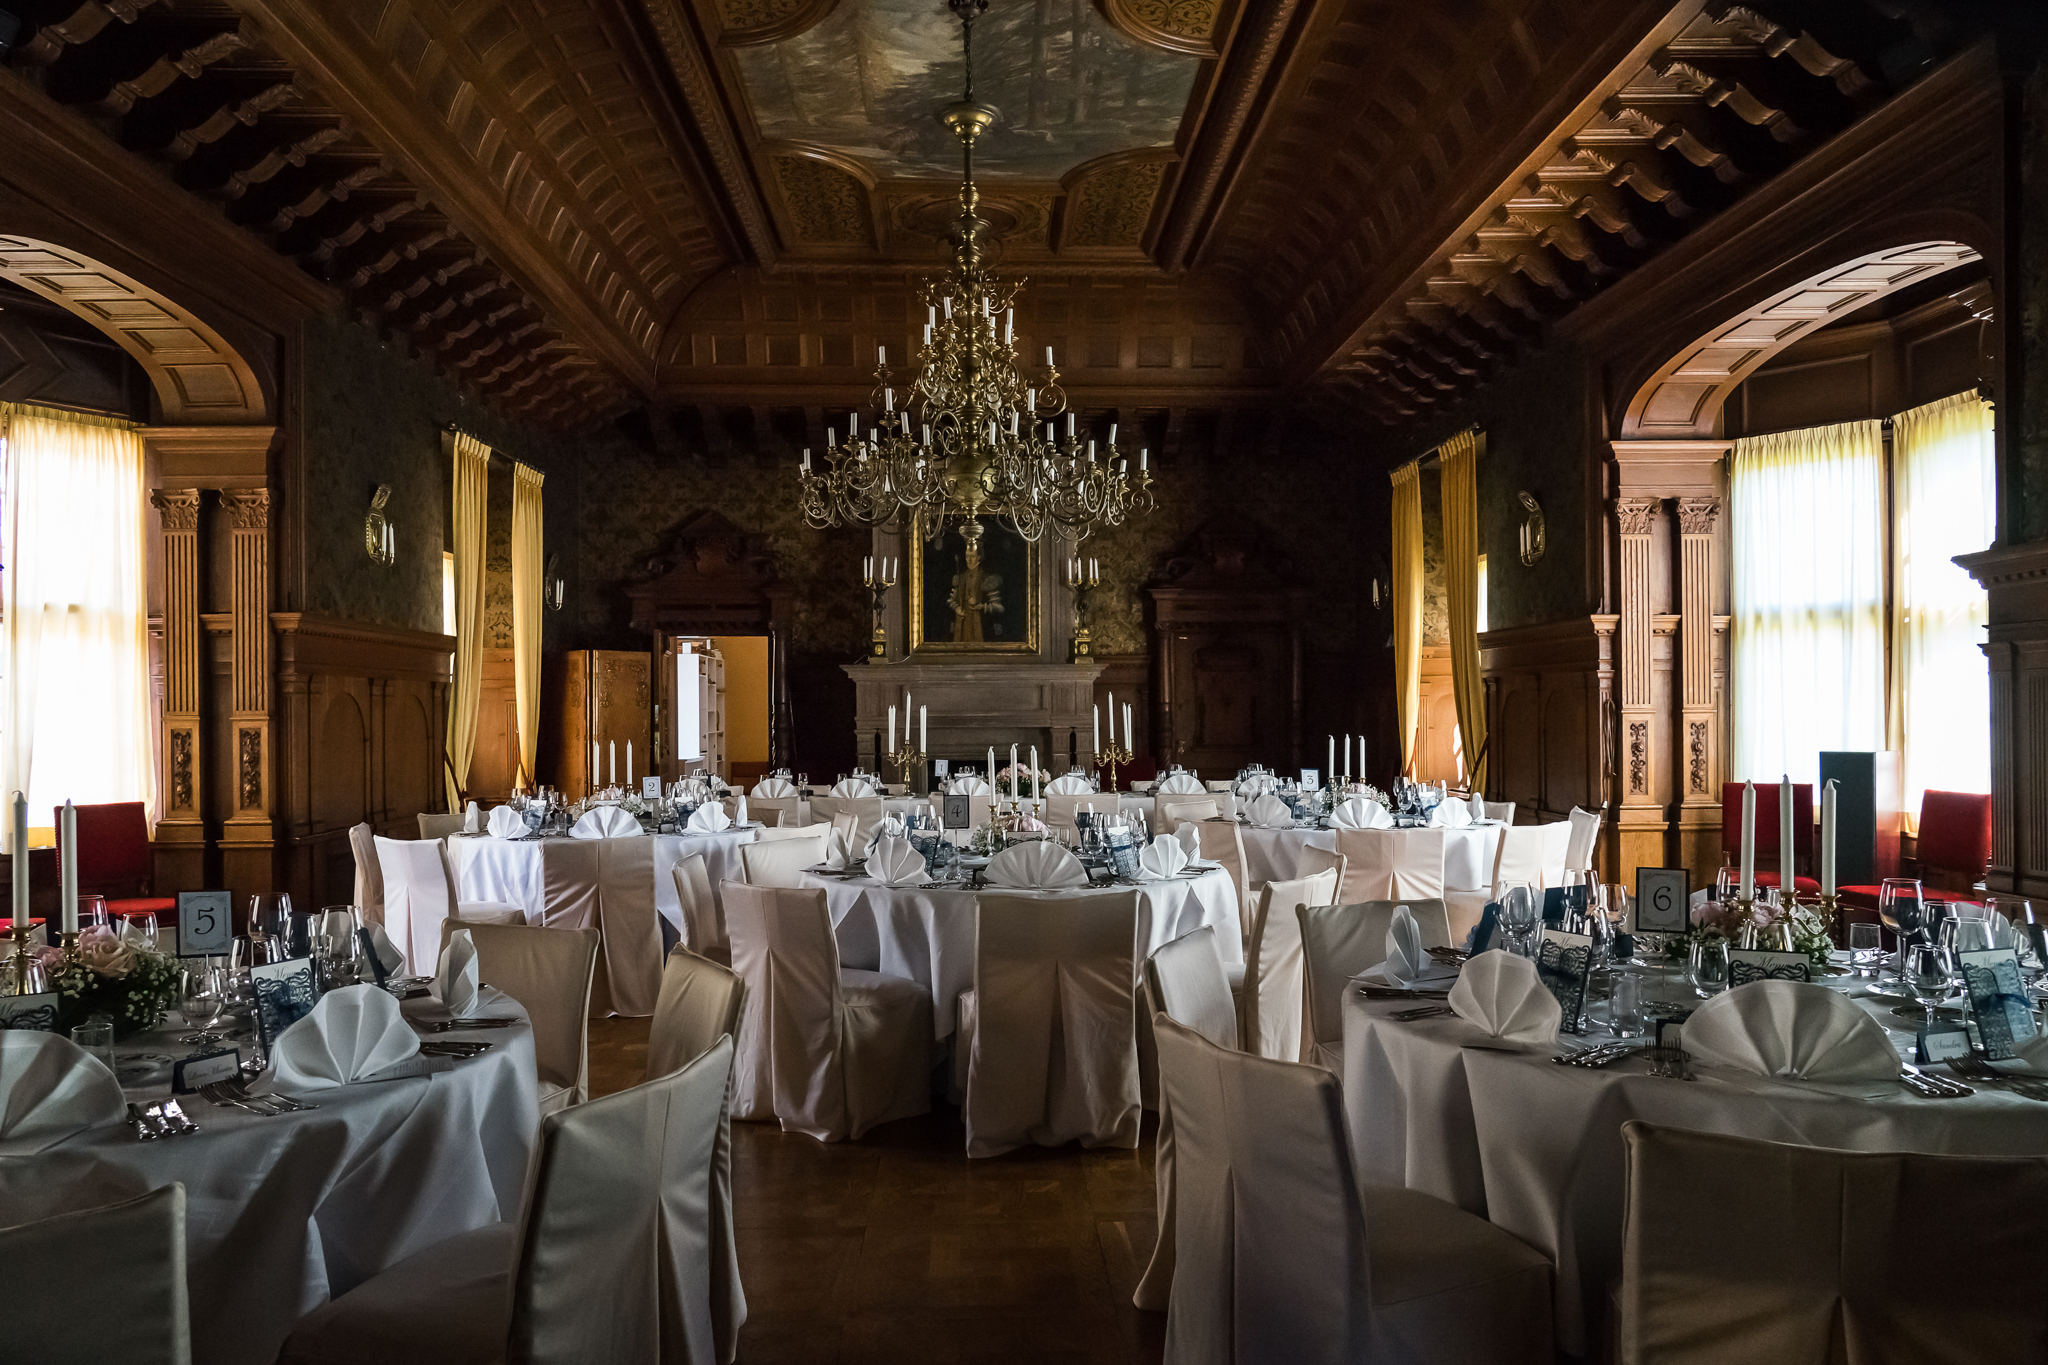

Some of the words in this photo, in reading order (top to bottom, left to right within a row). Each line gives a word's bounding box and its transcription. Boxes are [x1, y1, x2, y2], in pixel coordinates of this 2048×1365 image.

[1307, 775, 1314, 784] 3
[648, 782, 655, 792] 2
[951, 804, 962, 817] 4
[1653, 886, 1672, 911] 6
[194, 907, 215, 935] 5
[1754, 955, 1788, 969] Menu
